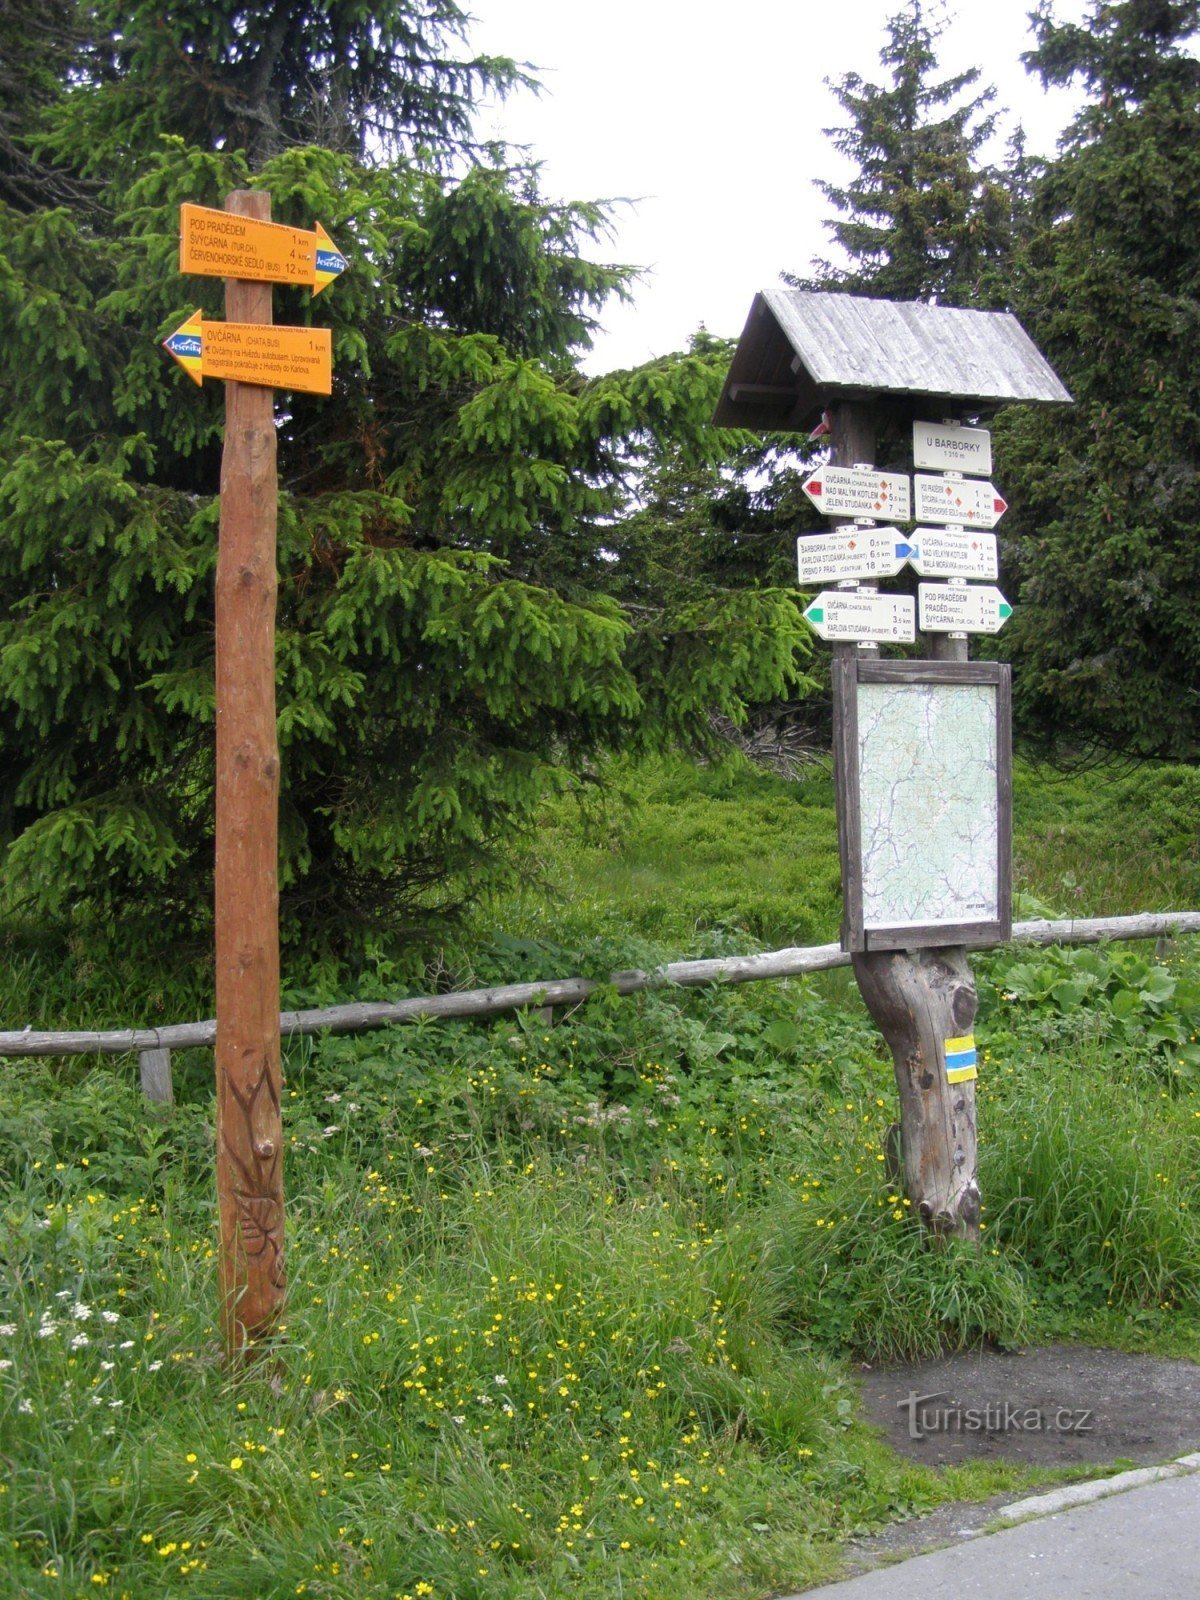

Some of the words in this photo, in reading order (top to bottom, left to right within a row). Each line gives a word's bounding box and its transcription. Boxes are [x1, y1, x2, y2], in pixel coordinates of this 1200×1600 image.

[190, 218, 206, 230] POD
[292, 235, 297, 244] 1
[298, 239, 308, 247] km
[190, 233, 228, 248] ŠVÝCÁRNA
[290, 250, 295, 259] 4
[190, 249, 243, 267] ČERVENOHORSKÉ
[244, 258, 264, 269] SEDLO
[286, 264, 295, 274] 12
[298, 268, 308, 276] km
[207, 330, 241, 342] OVČÁRNA
[309, 341, 313, 350] 1
[315, 344, 326, 352] km
[927, 438, 932, 446] U
[935, 438, 980, 452] BARBORKY
[826, 475, 851, 484] OVČÁRNA
[801, 544, 826, 553] BARBORKA
[866, 562, 876, 570] 18
